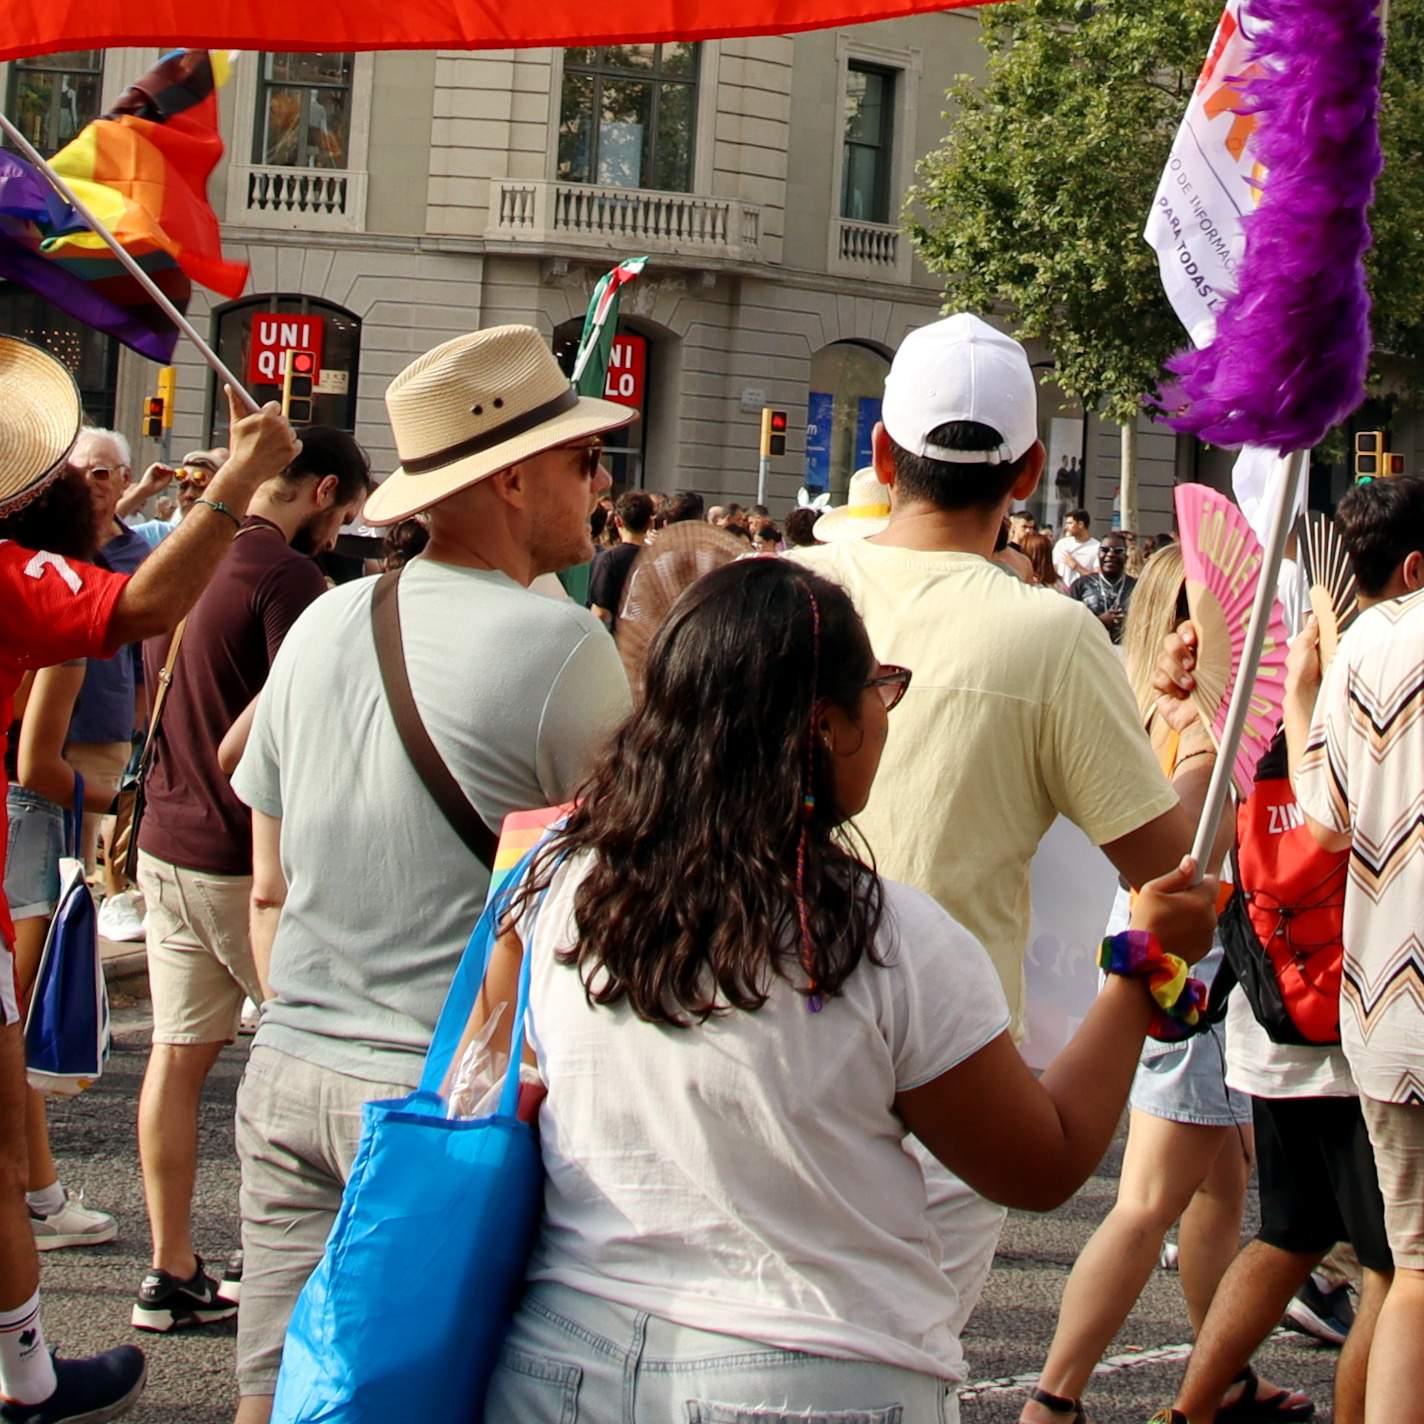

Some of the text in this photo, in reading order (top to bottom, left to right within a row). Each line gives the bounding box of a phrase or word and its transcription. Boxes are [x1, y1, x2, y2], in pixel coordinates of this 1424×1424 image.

[1158, 196, 1182, 241] PARA
[1176, 239, 1213, 298] TODAS
[1176, 173, 1193, 196] DE
[1190, 194, 1238, 278] INFORMAC
[259, 321, 310, 348] UNI
